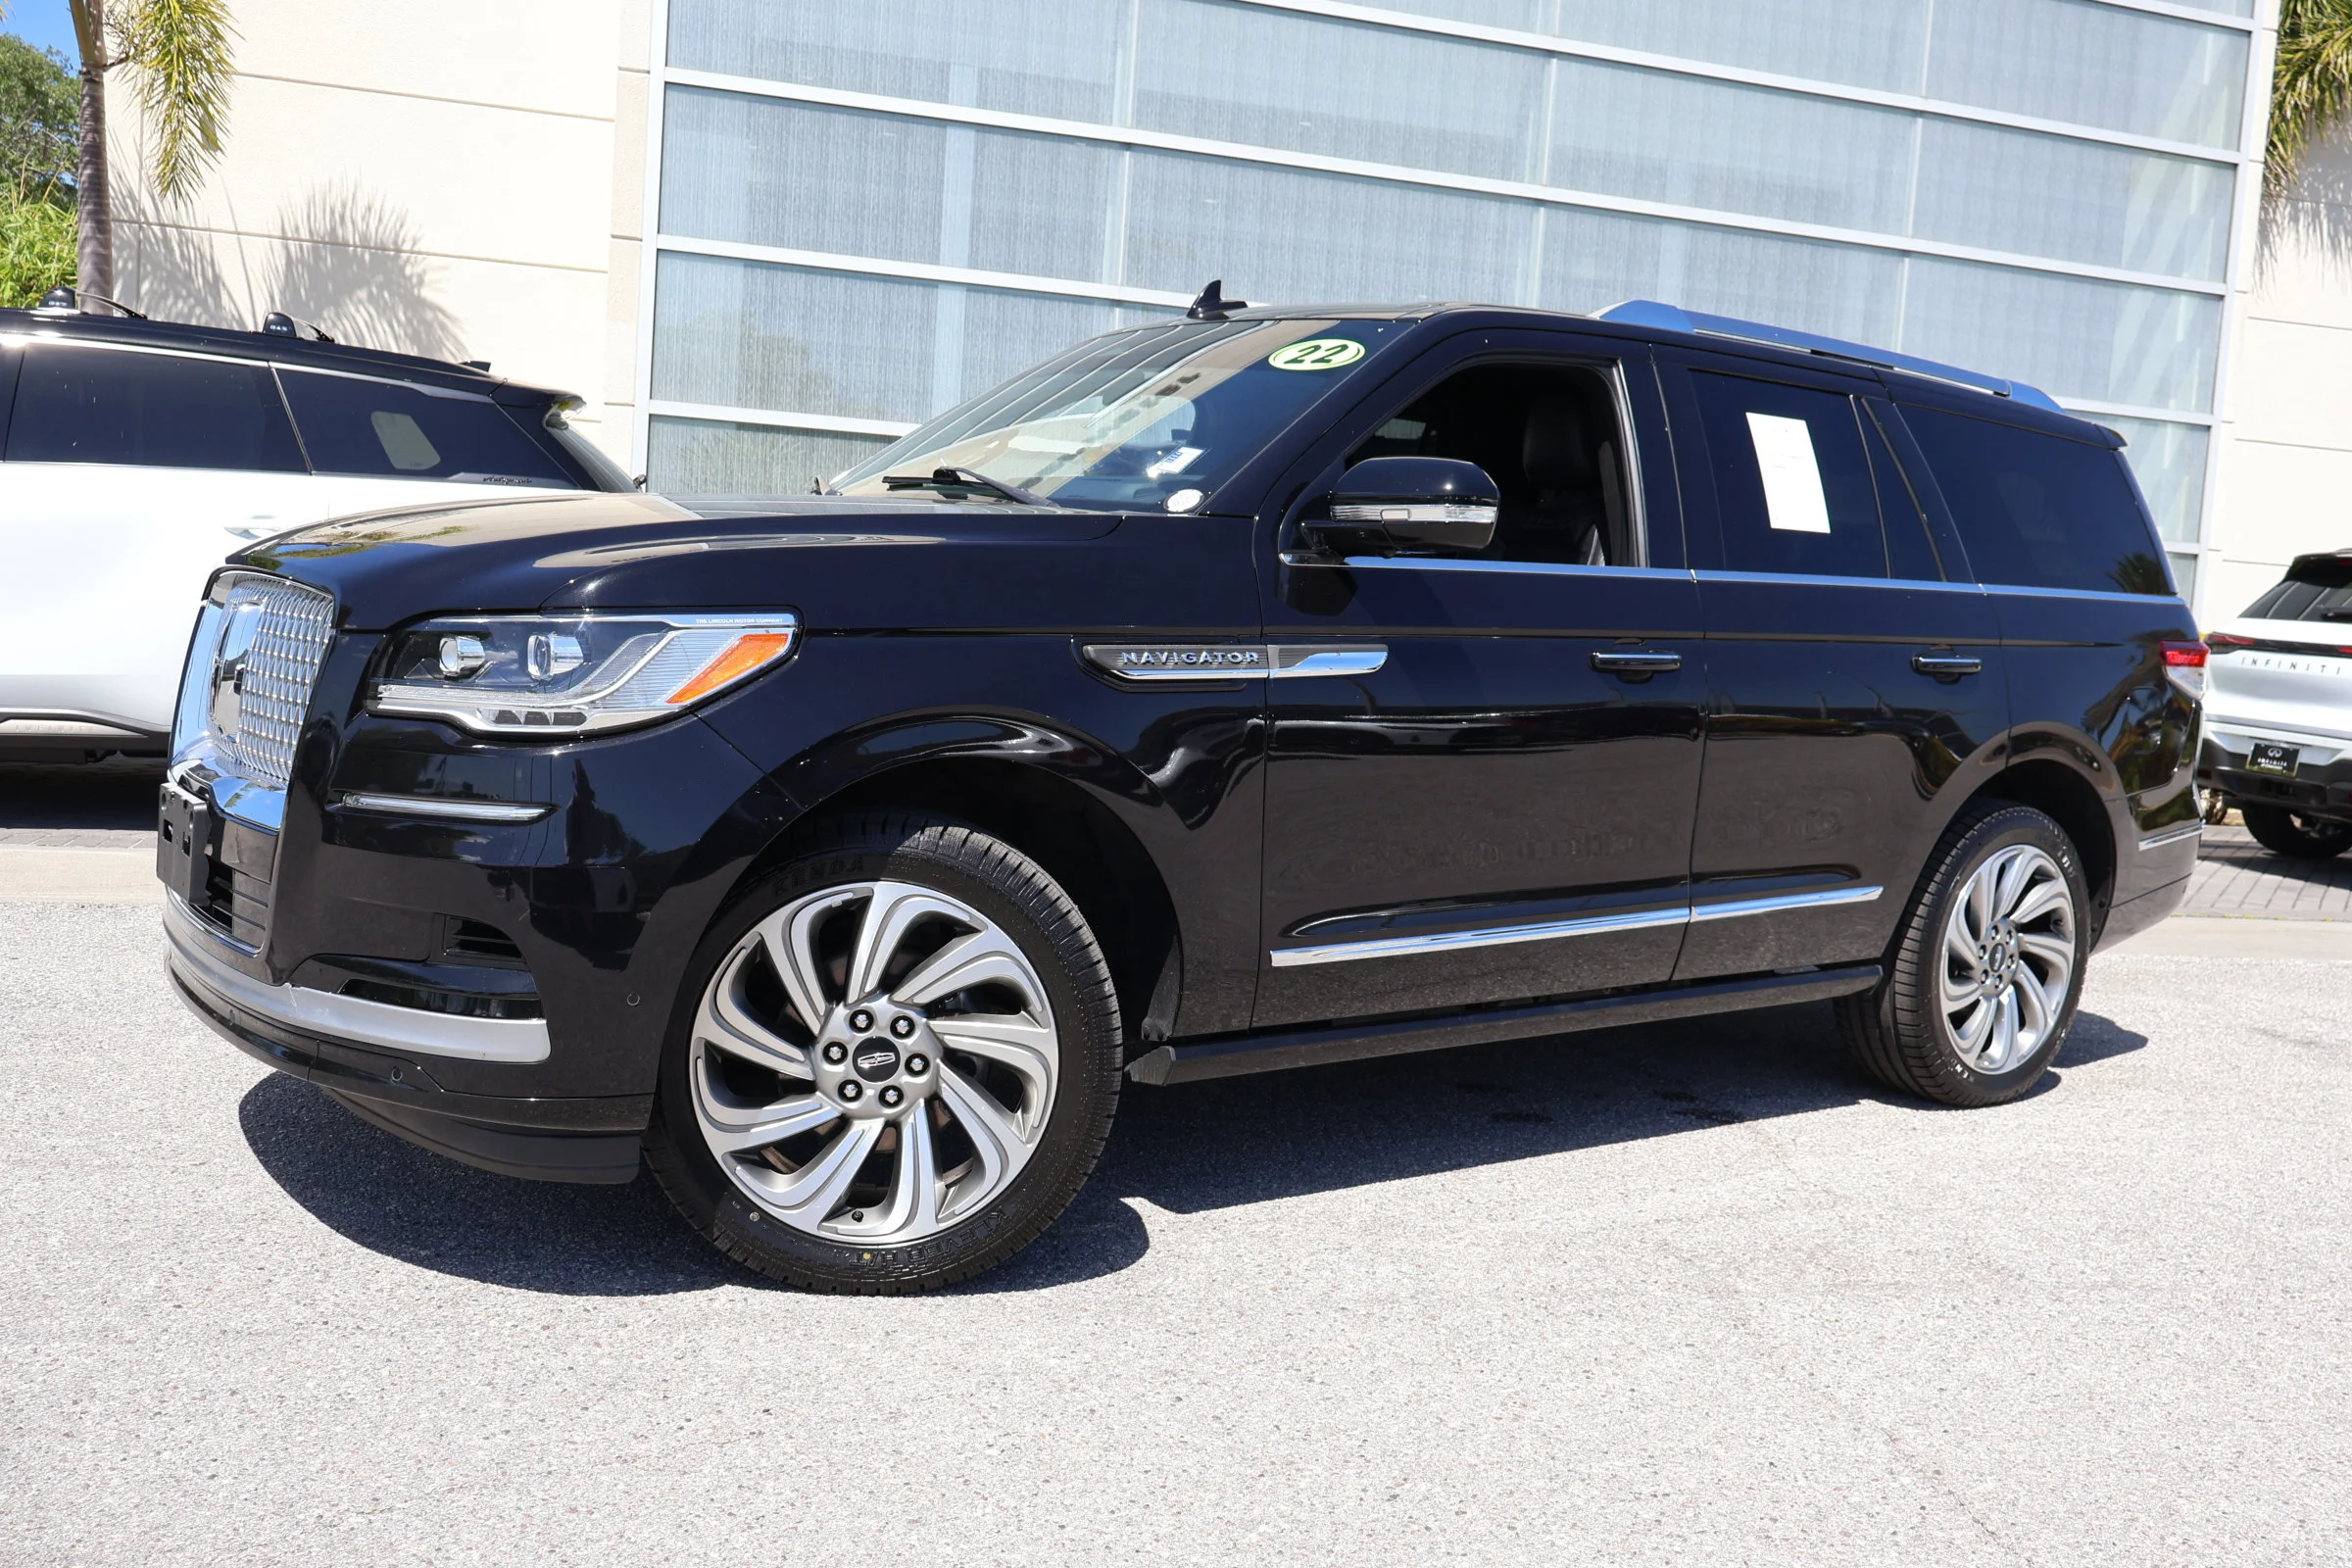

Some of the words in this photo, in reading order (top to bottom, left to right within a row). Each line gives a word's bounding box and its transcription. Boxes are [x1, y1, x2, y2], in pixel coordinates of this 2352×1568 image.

[1283, 344, 1349, 365] 22
[1121, 651, 1259, 665] NAVIGATOR
[2241, 656, 2341, 675] INFINITI
[772, 856, 866, 897] KENDA
[907, 1206, 1008, 1263] KLEVER
